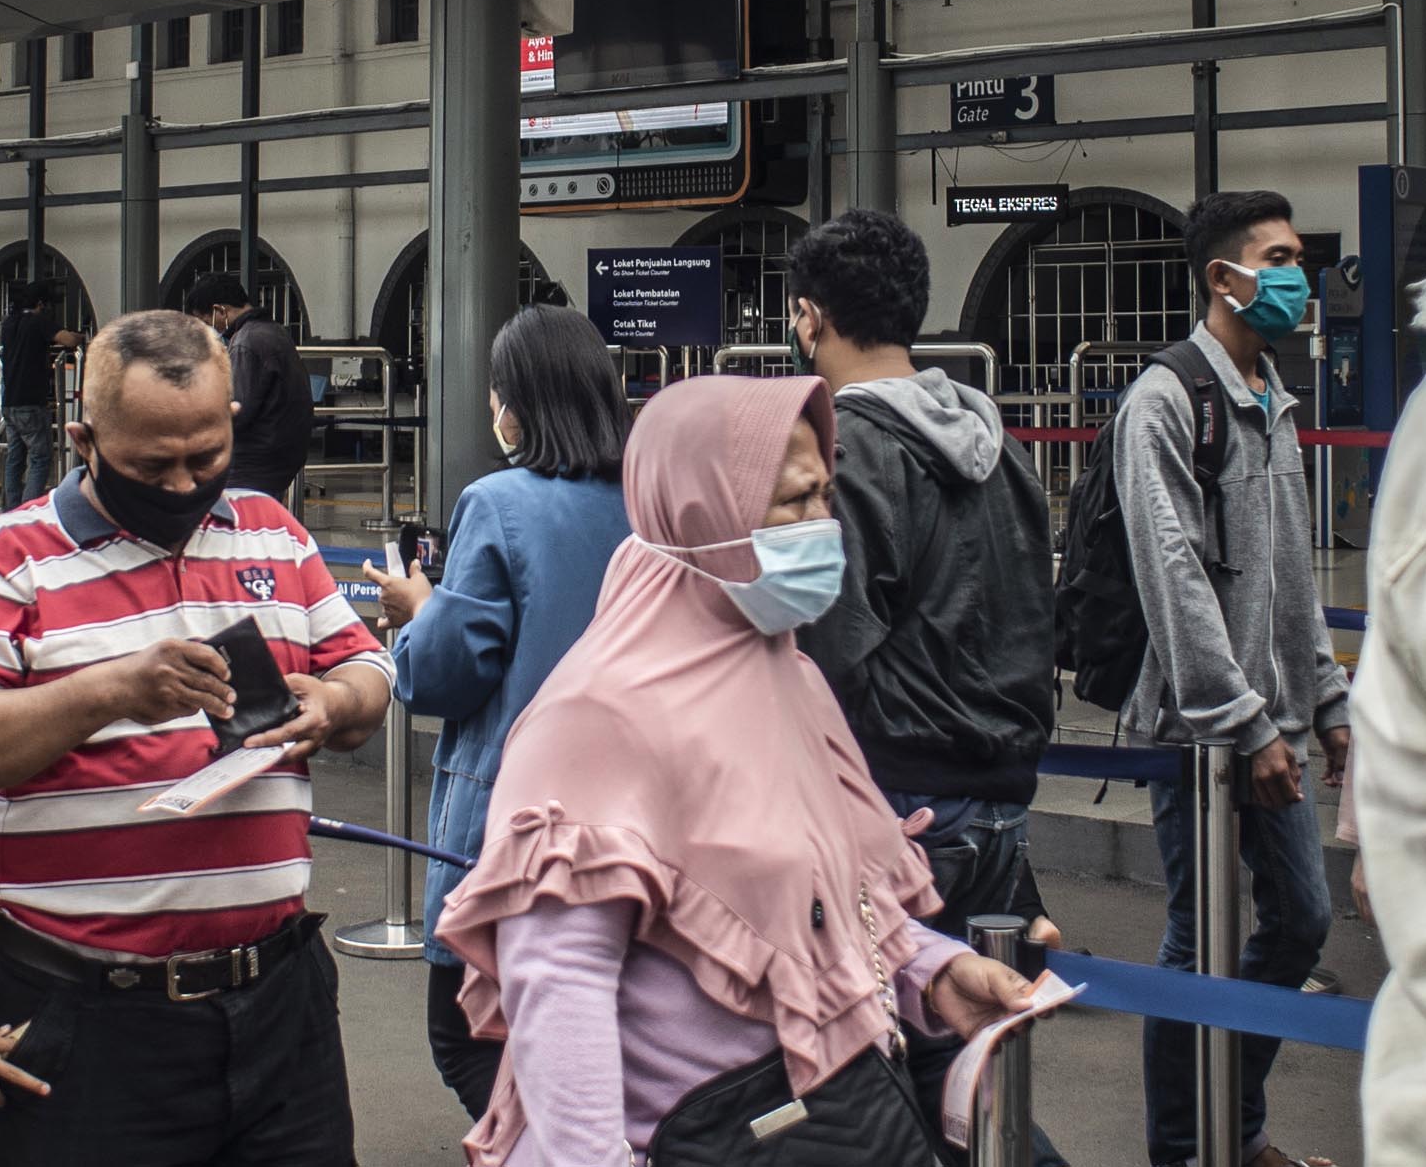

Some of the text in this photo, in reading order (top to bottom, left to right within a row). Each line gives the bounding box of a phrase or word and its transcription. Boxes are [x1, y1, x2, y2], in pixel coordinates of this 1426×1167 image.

[957, 76, 1039, 120] Pintu 3
[957, 106, 989, 123] Gate
[954, 196, 1058, 213] TEGAL EKSPRES
[613, 258, 711, 269] Loket Penjualan Langsung
[613, 289, 680, 298] Loket Pembatalan
[637, 320, 656, 328] Tiket
